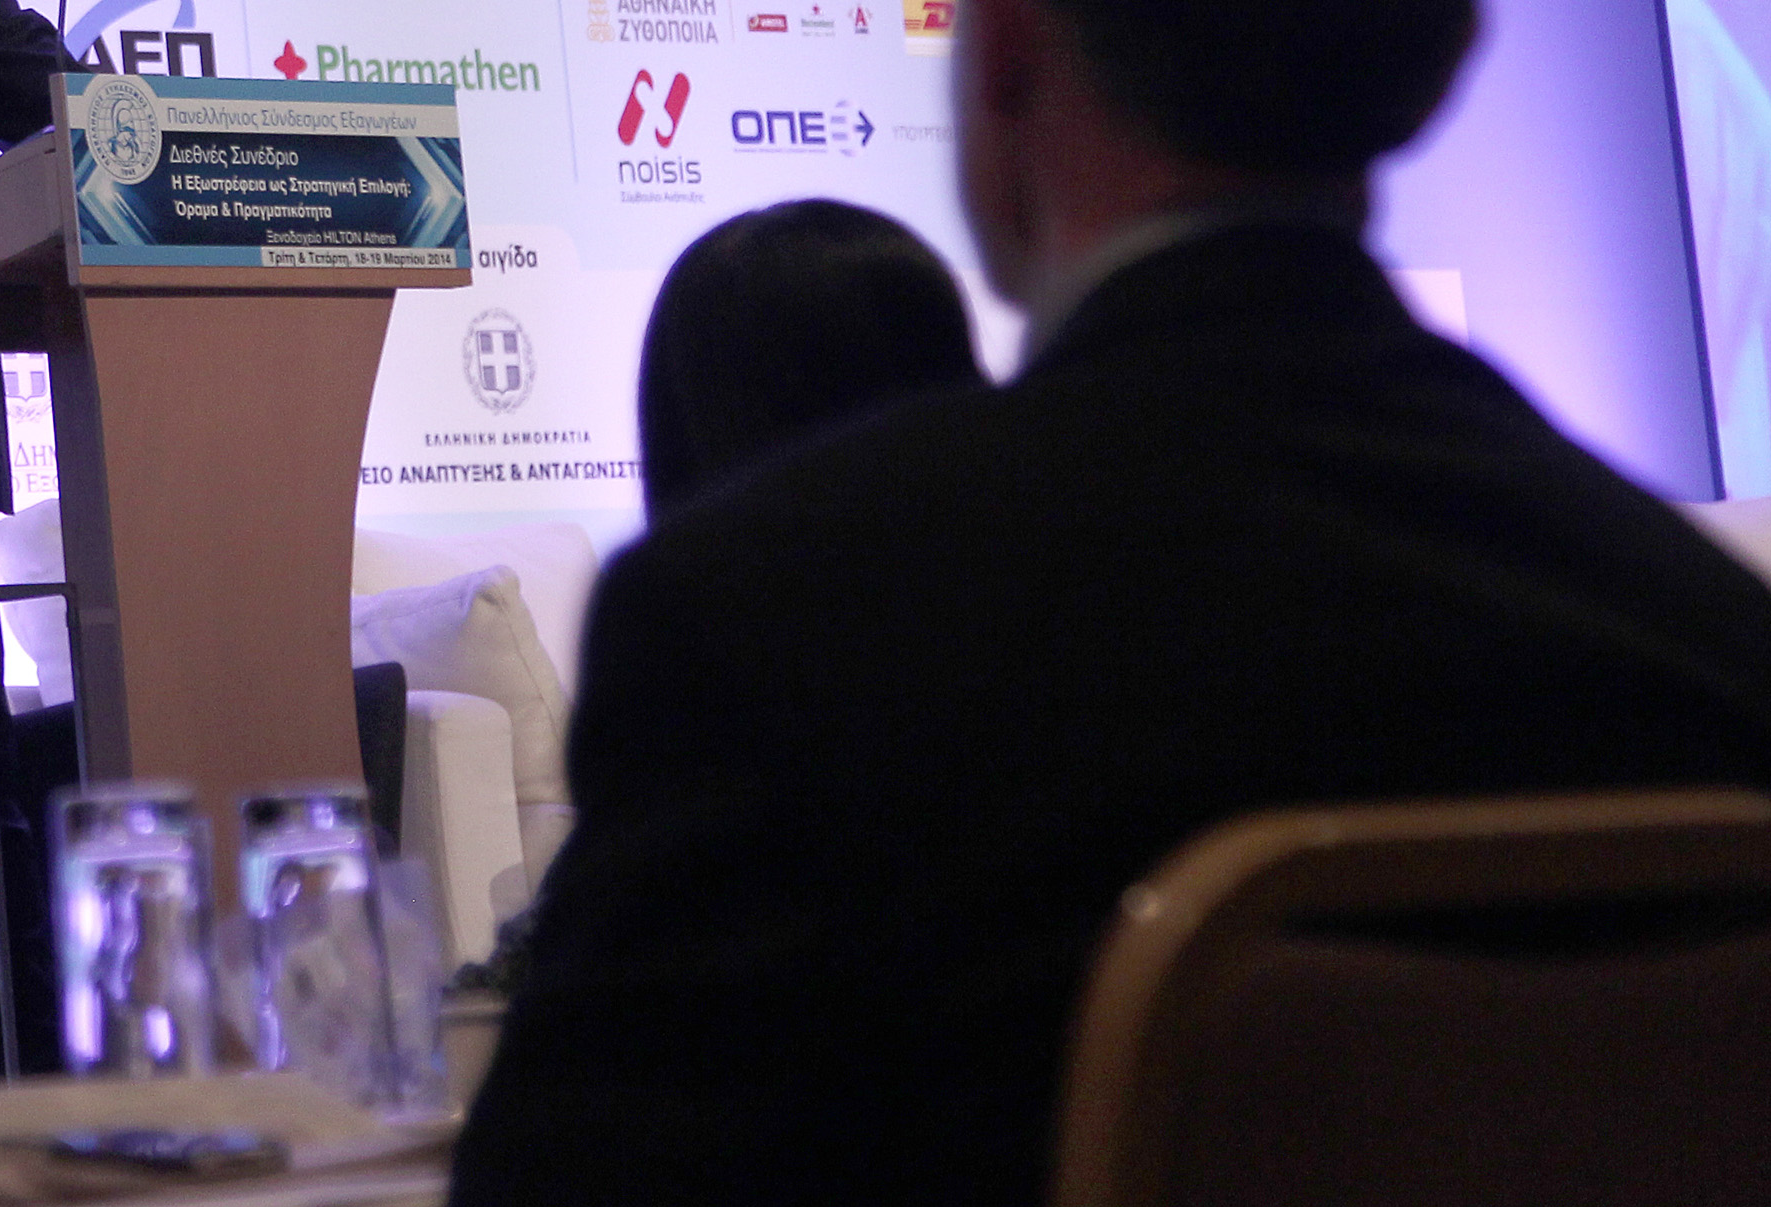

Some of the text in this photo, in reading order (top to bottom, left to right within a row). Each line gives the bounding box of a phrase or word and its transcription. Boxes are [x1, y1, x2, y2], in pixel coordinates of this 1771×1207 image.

[618, 19, 719, 44] ΖΥΘΟΠΟΙΙΑ
[316, 44, 541, 92] Pharmathen
[167, 107, 417, 133] Πανελλήνιος Σύνδεσμος Εξαγωγέων
[169, 145, 299, 169] Διεθνές Συνέδριο
[619, 155, 702, 183] noisis
[185, 175, 267, 194] Εξωστρέφεια
[271, 179, 288, 193] ως
[289, 176, 358, 197] Στρατηγική
[359, 178, 411, 198] Επιλογή:
[175, 199, 333, 222] Όραμα & Πραγματικότητα
[323, 231, 362, 244] HILTON
[363, 232, 397, 245] Athens
[269, 251, 296, 267] Τρίτη
[299, 253, 306, 264] &
[355, 253, 381, 265] 18-19
[428, 254, 451, 265] 2014
[479, 244, 538, 274] αιγίδα
[425, 431, 592, 447] ΕΛΛΗΝΙΚΗ ΔΗΜΟΚΡΑΤΙΑ
[400, 464, 506, 484] ΑΝΑΠΤΥΞΗΣ
[511, 463, 523, 482] &
[529, 461, 641, 482] ΑΝΤΑΓΩΝΙΣΤ
